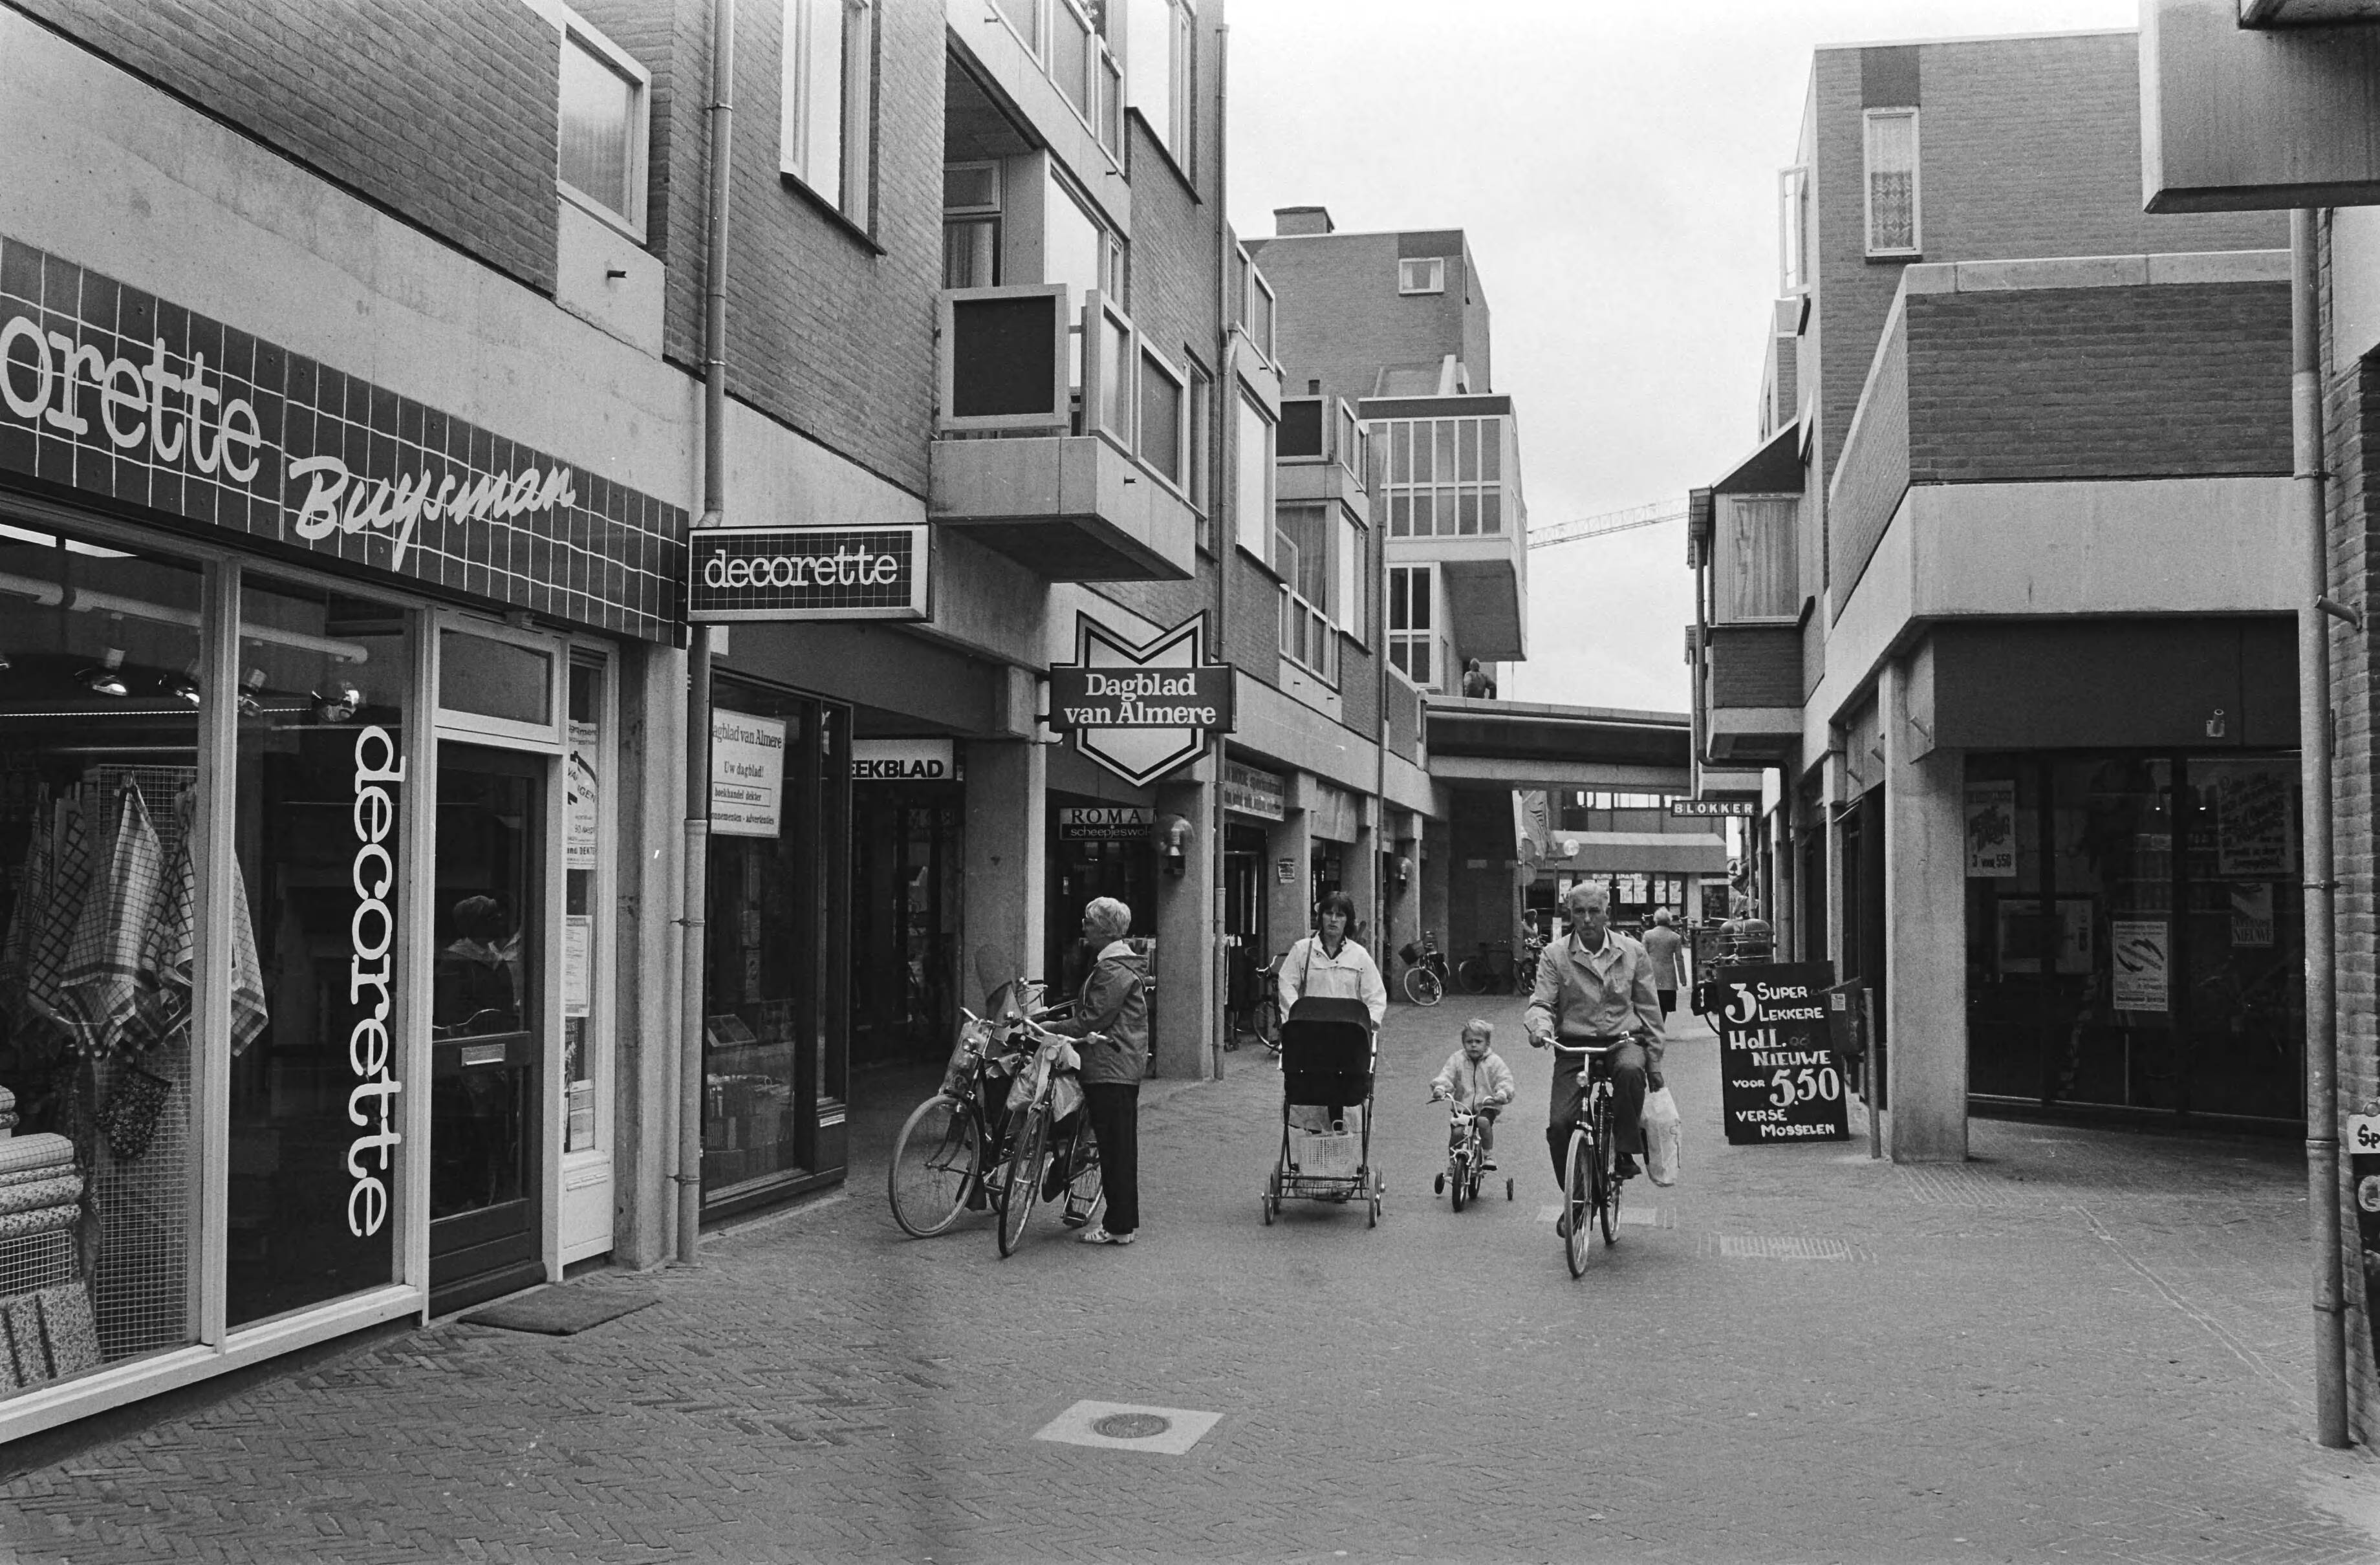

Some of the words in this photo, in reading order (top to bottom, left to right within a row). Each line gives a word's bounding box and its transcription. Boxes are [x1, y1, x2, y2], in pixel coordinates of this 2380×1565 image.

[288, 455, 578, 572] Buysman
[704, 545, 898, 588] decorette
[1086, 673, 1196, 700] Dagblad
[1064, 706, 1112, 724] van
[1116, 702, 1217, 724] Almere
[712, 722, 739, 743] agblad
[741, 730, 754, 744] van
[755, 729, 782, 749] Almere
[724, 761, 735, 773] Uw
[737, 762, 764, 779] dagblad!
[852, 759, 944, 778] EKBLAD
[1071, 809, 1141, 823] ROMA
[1674, 803, 1754, 814] BLOKKER
[347, 725, 406, 1237] decorette
[1725, 983, 1757, 1024] 3
[1751, 1050, 1832, 1066] NIEUWE
